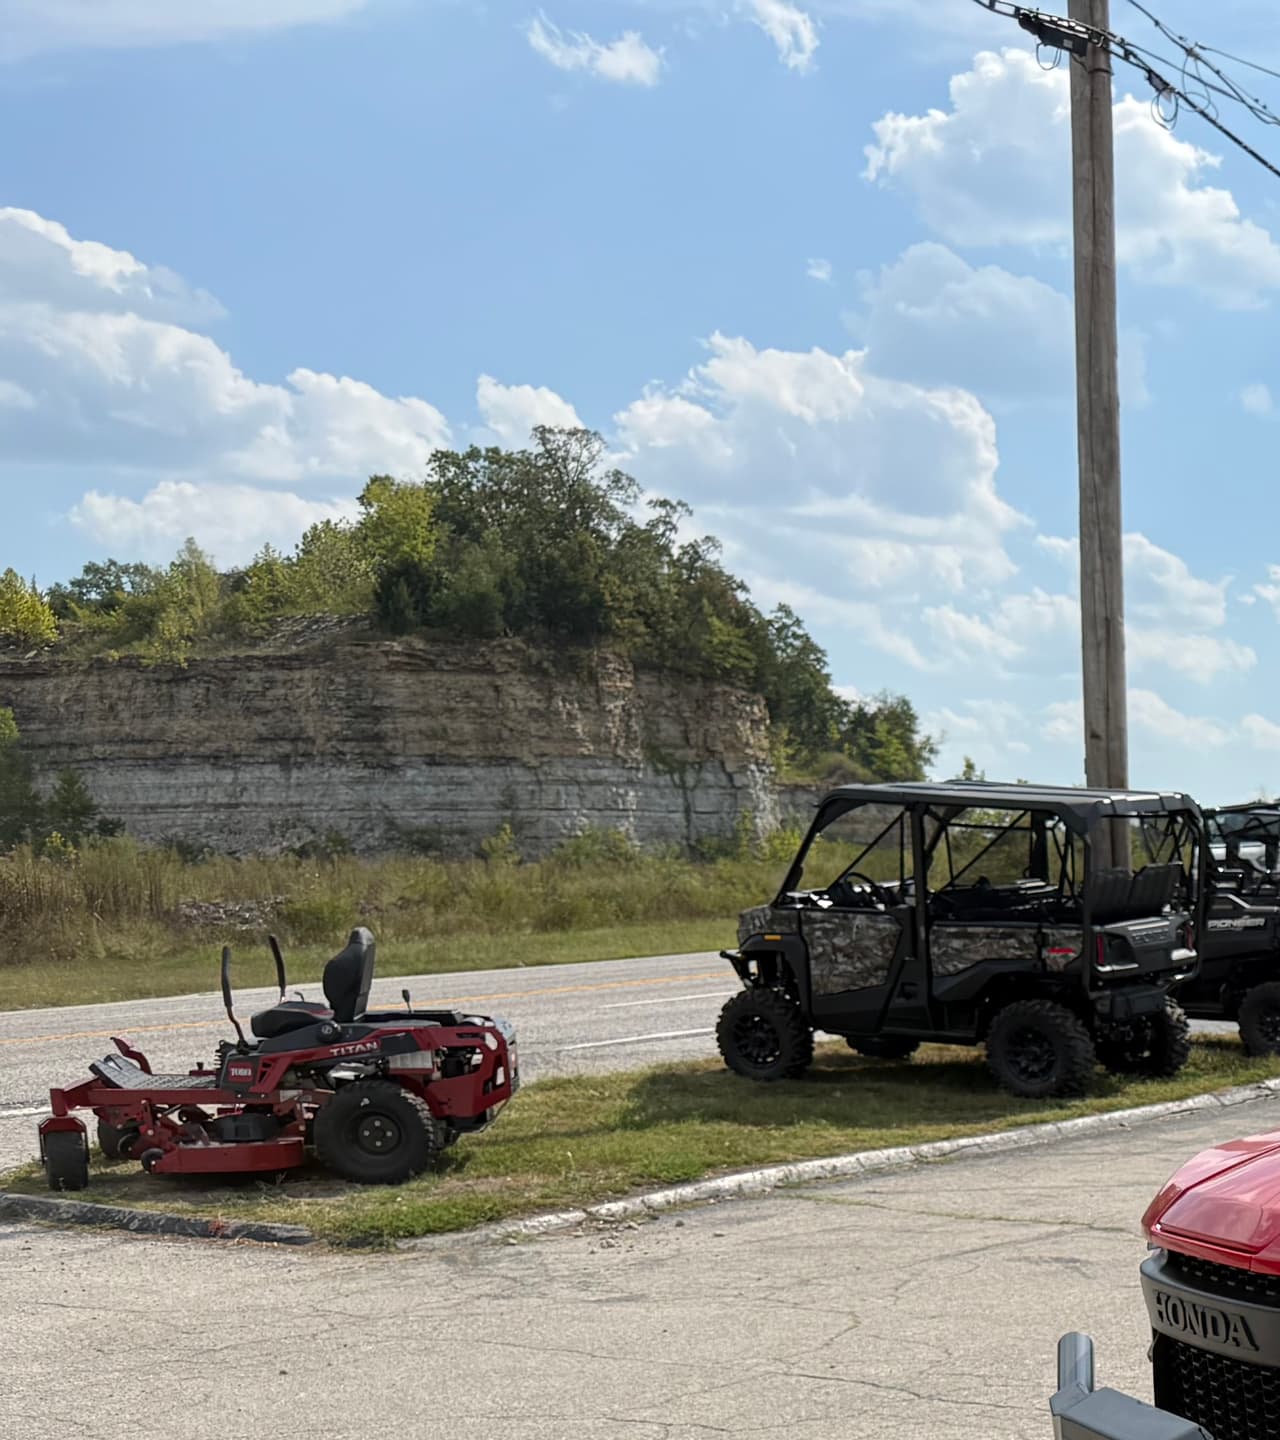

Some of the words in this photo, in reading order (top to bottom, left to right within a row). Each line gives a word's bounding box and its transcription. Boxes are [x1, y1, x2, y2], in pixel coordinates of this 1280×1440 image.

[1208, 917, 1265, 929] PIONEER
[330, 1041, 378, 1057] TITAN
[1153, 1288, 1260, 1352] HONDA
